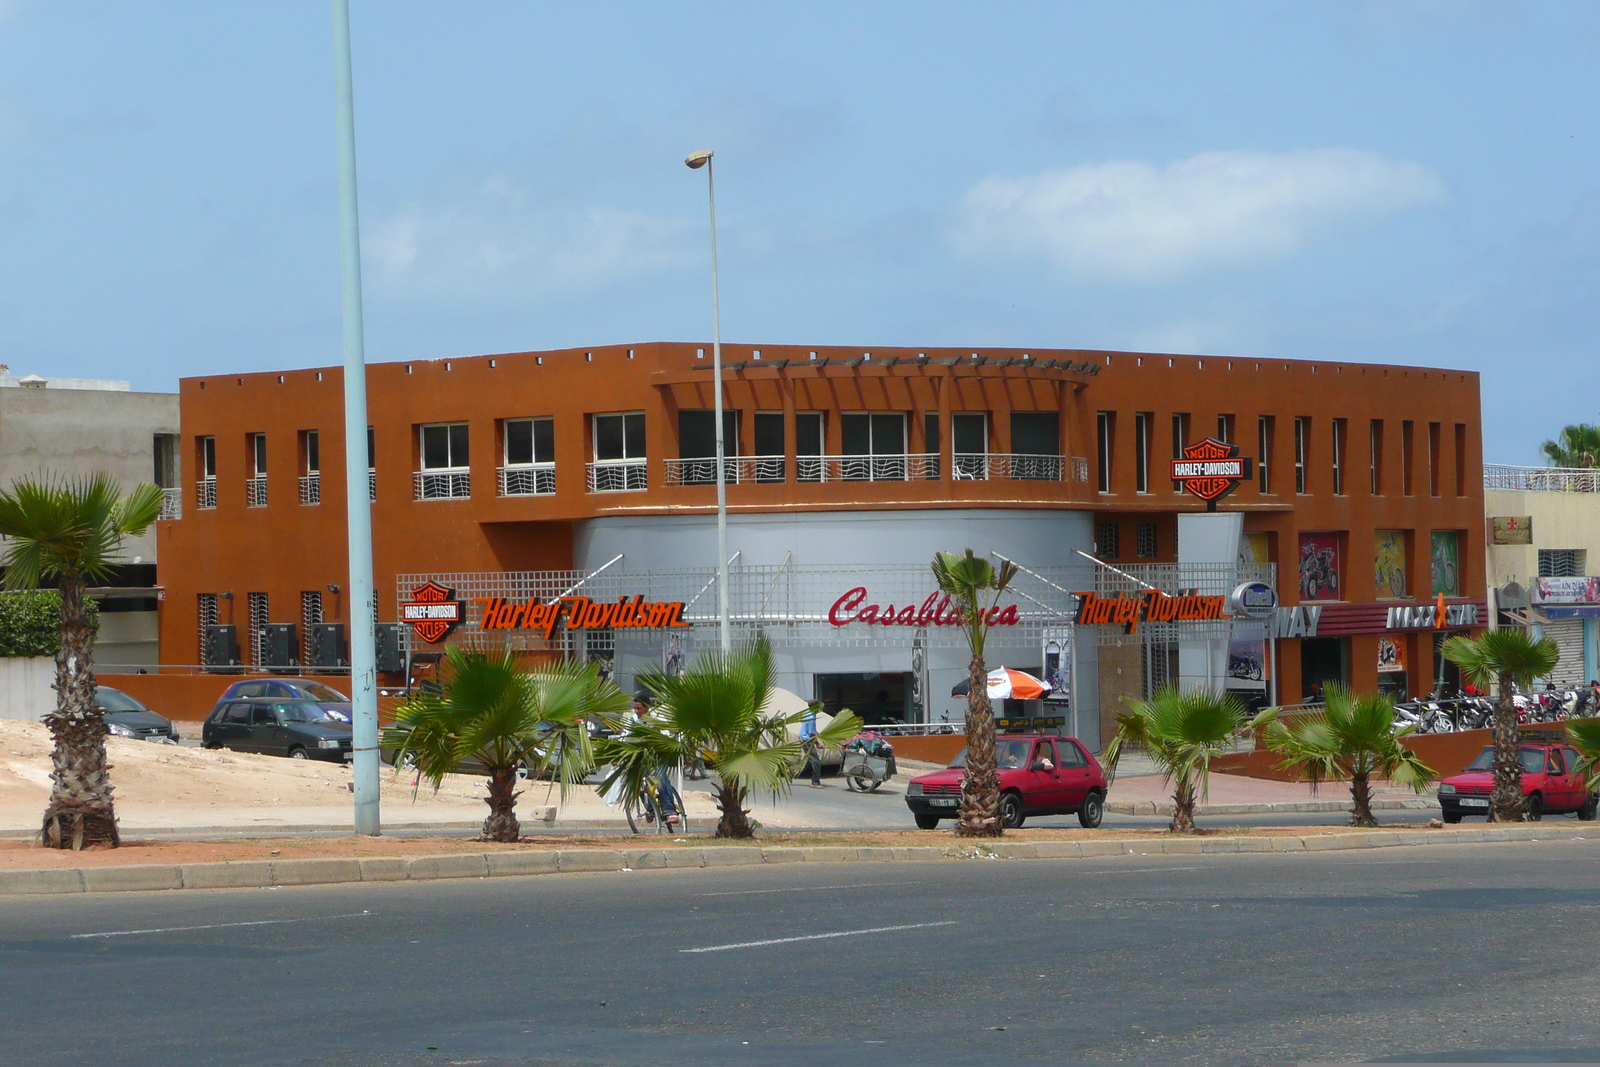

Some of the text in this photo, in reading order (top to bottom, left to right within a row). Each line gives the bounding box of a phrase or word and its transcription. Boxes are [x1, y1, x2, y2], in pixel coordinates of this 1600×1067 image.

[1190, 444, 1225, 459] MOTOR
[1174, 462, 1241, 477] HARLEY-DAVIDSON
[1189, 479, 1225, 495] CYCLES
[416, 587, 444, 602] MOTOR
[404, 604, 457, 619] HARLEY-DAVIDSON
[472, 594, 692, 640] Harley-Davidson
[1074, 588, 1232, 635] Harley-Davidson
[1386, 604, 1479, 628] MAXX STAR
[416, 621, 446, 638] CYCLES
